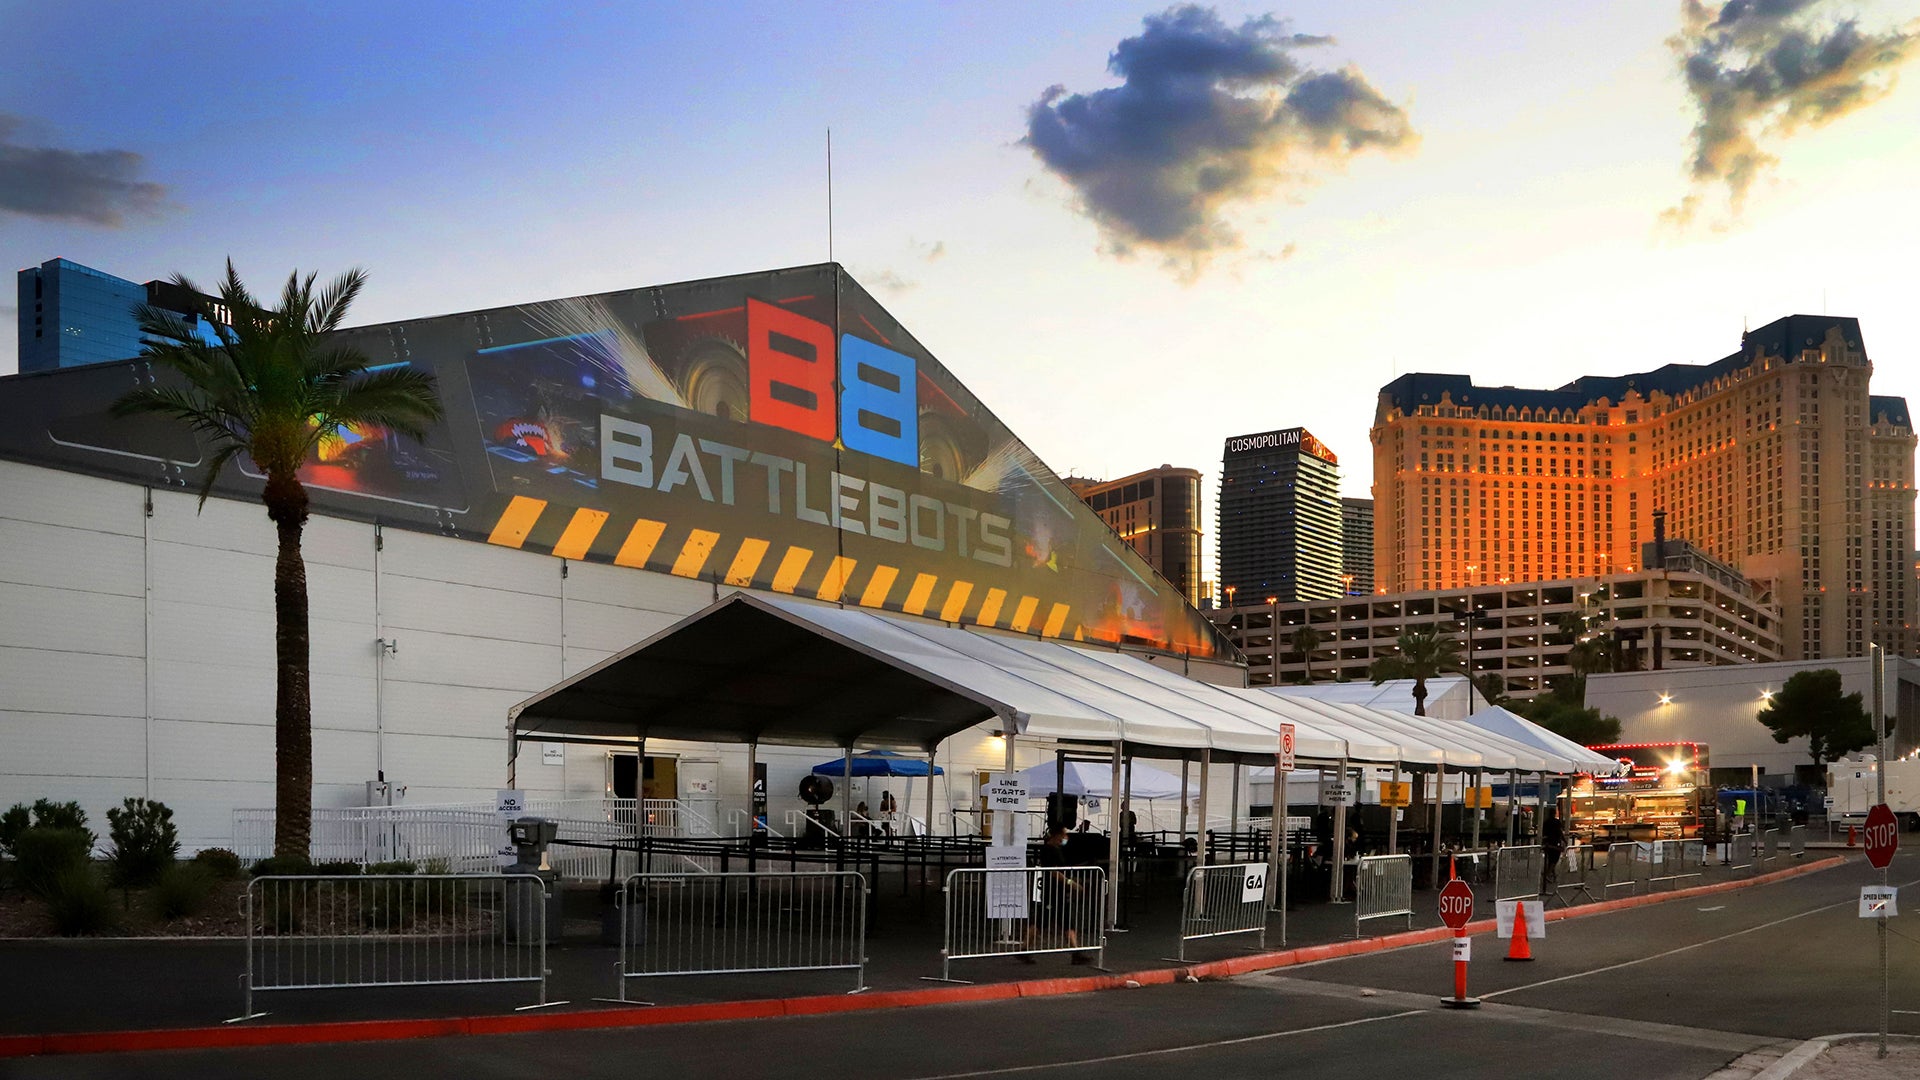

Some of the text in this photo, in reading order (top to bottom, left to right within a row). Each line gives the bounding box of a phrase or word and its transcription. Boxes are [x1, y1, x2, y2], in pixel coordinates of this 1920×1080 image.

[1231, 431, 1300, 453] COSMOPOLITAN
[600, 413, 1013, 569] BATTLEBOTS
[991, 788, 1026, 796] STARTS
[503, 798, 516, 806] NO
[996, 797, 1019, 805] HERE
[1087, 799, 1100, 809] GA
[1865, 822, 1896, 851] STOP
[1246, 874, 1263, 890] GA
[1863, 893, 1893, 901] SPEED LIMIT
[1441, 895, 1471, 915] STOP
